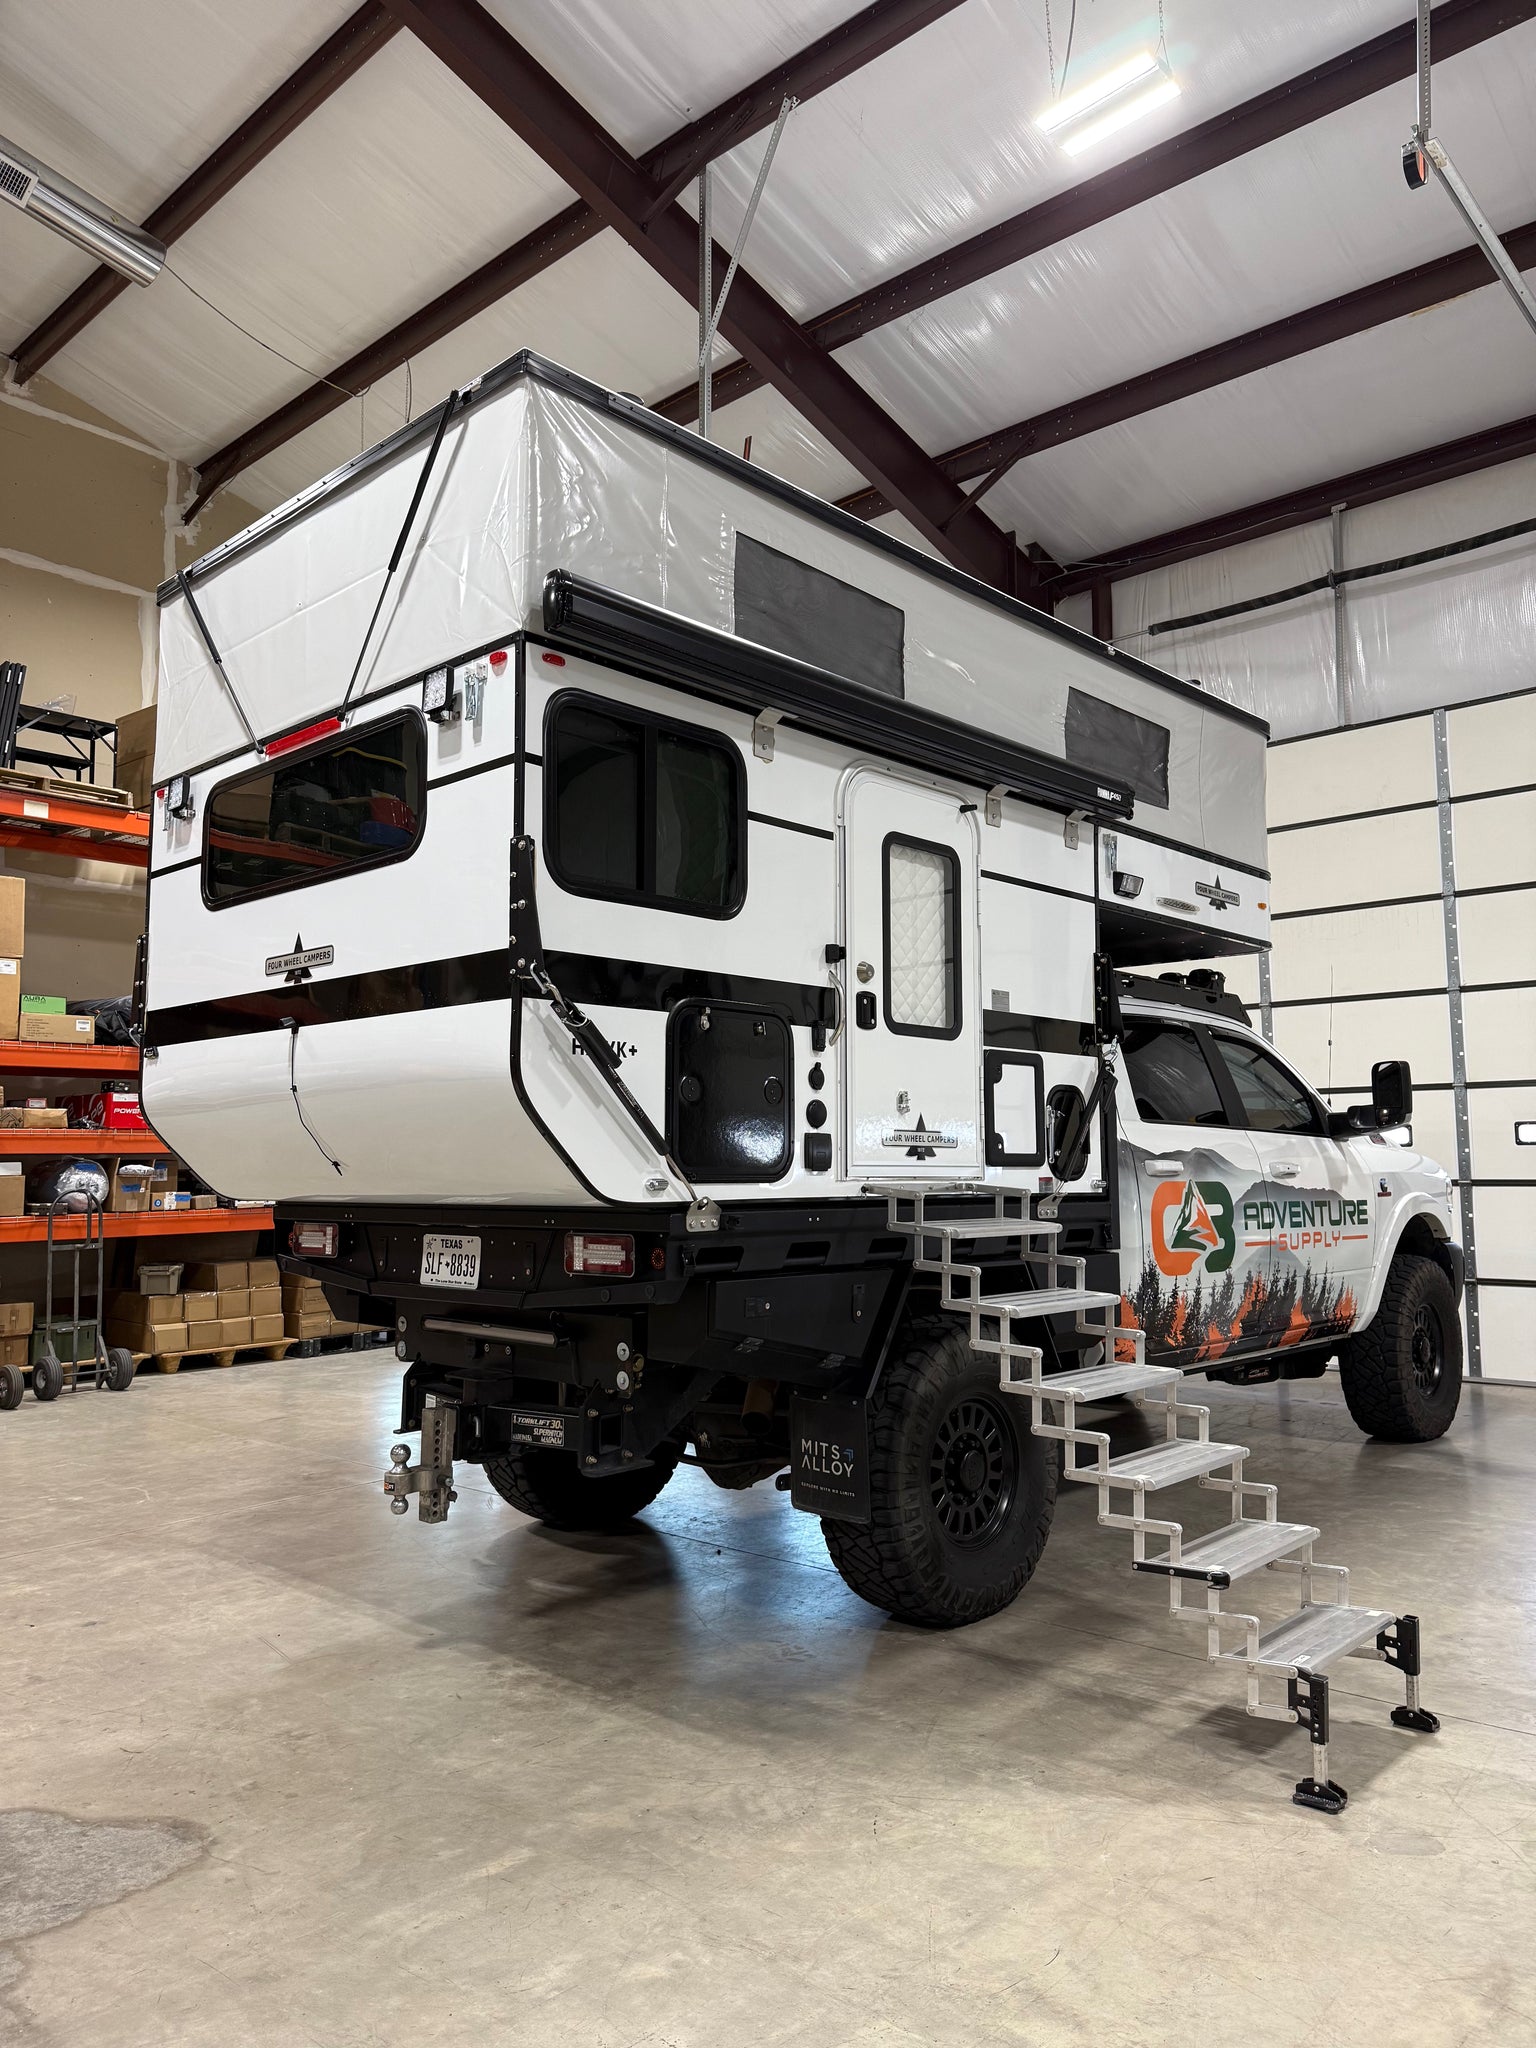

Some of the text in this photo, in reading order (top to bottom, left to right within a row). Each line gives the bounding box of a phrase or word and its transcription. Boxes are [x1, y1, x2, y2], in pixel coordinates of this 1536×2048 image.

[268, 951, 331, 970] FOUR WHEEL CAMPERS
[572, 1038, 638, 1058] HK+
[904, 1134, 926, 1143] WHEEL
[927, 1135, 955, 1144] CAMPERS
[1243, 1199, 1369, 1230] ADVENTURE
[441, 1239, 463, 1249] TEXAS
[1278, 1231, 1341, 1251] SUPPLY
[425, 1252, 476, 1277] SLF 8839
[801, 1438, 840, 1460] MITS
[801, 1454, 854, 1478] ALLOY
